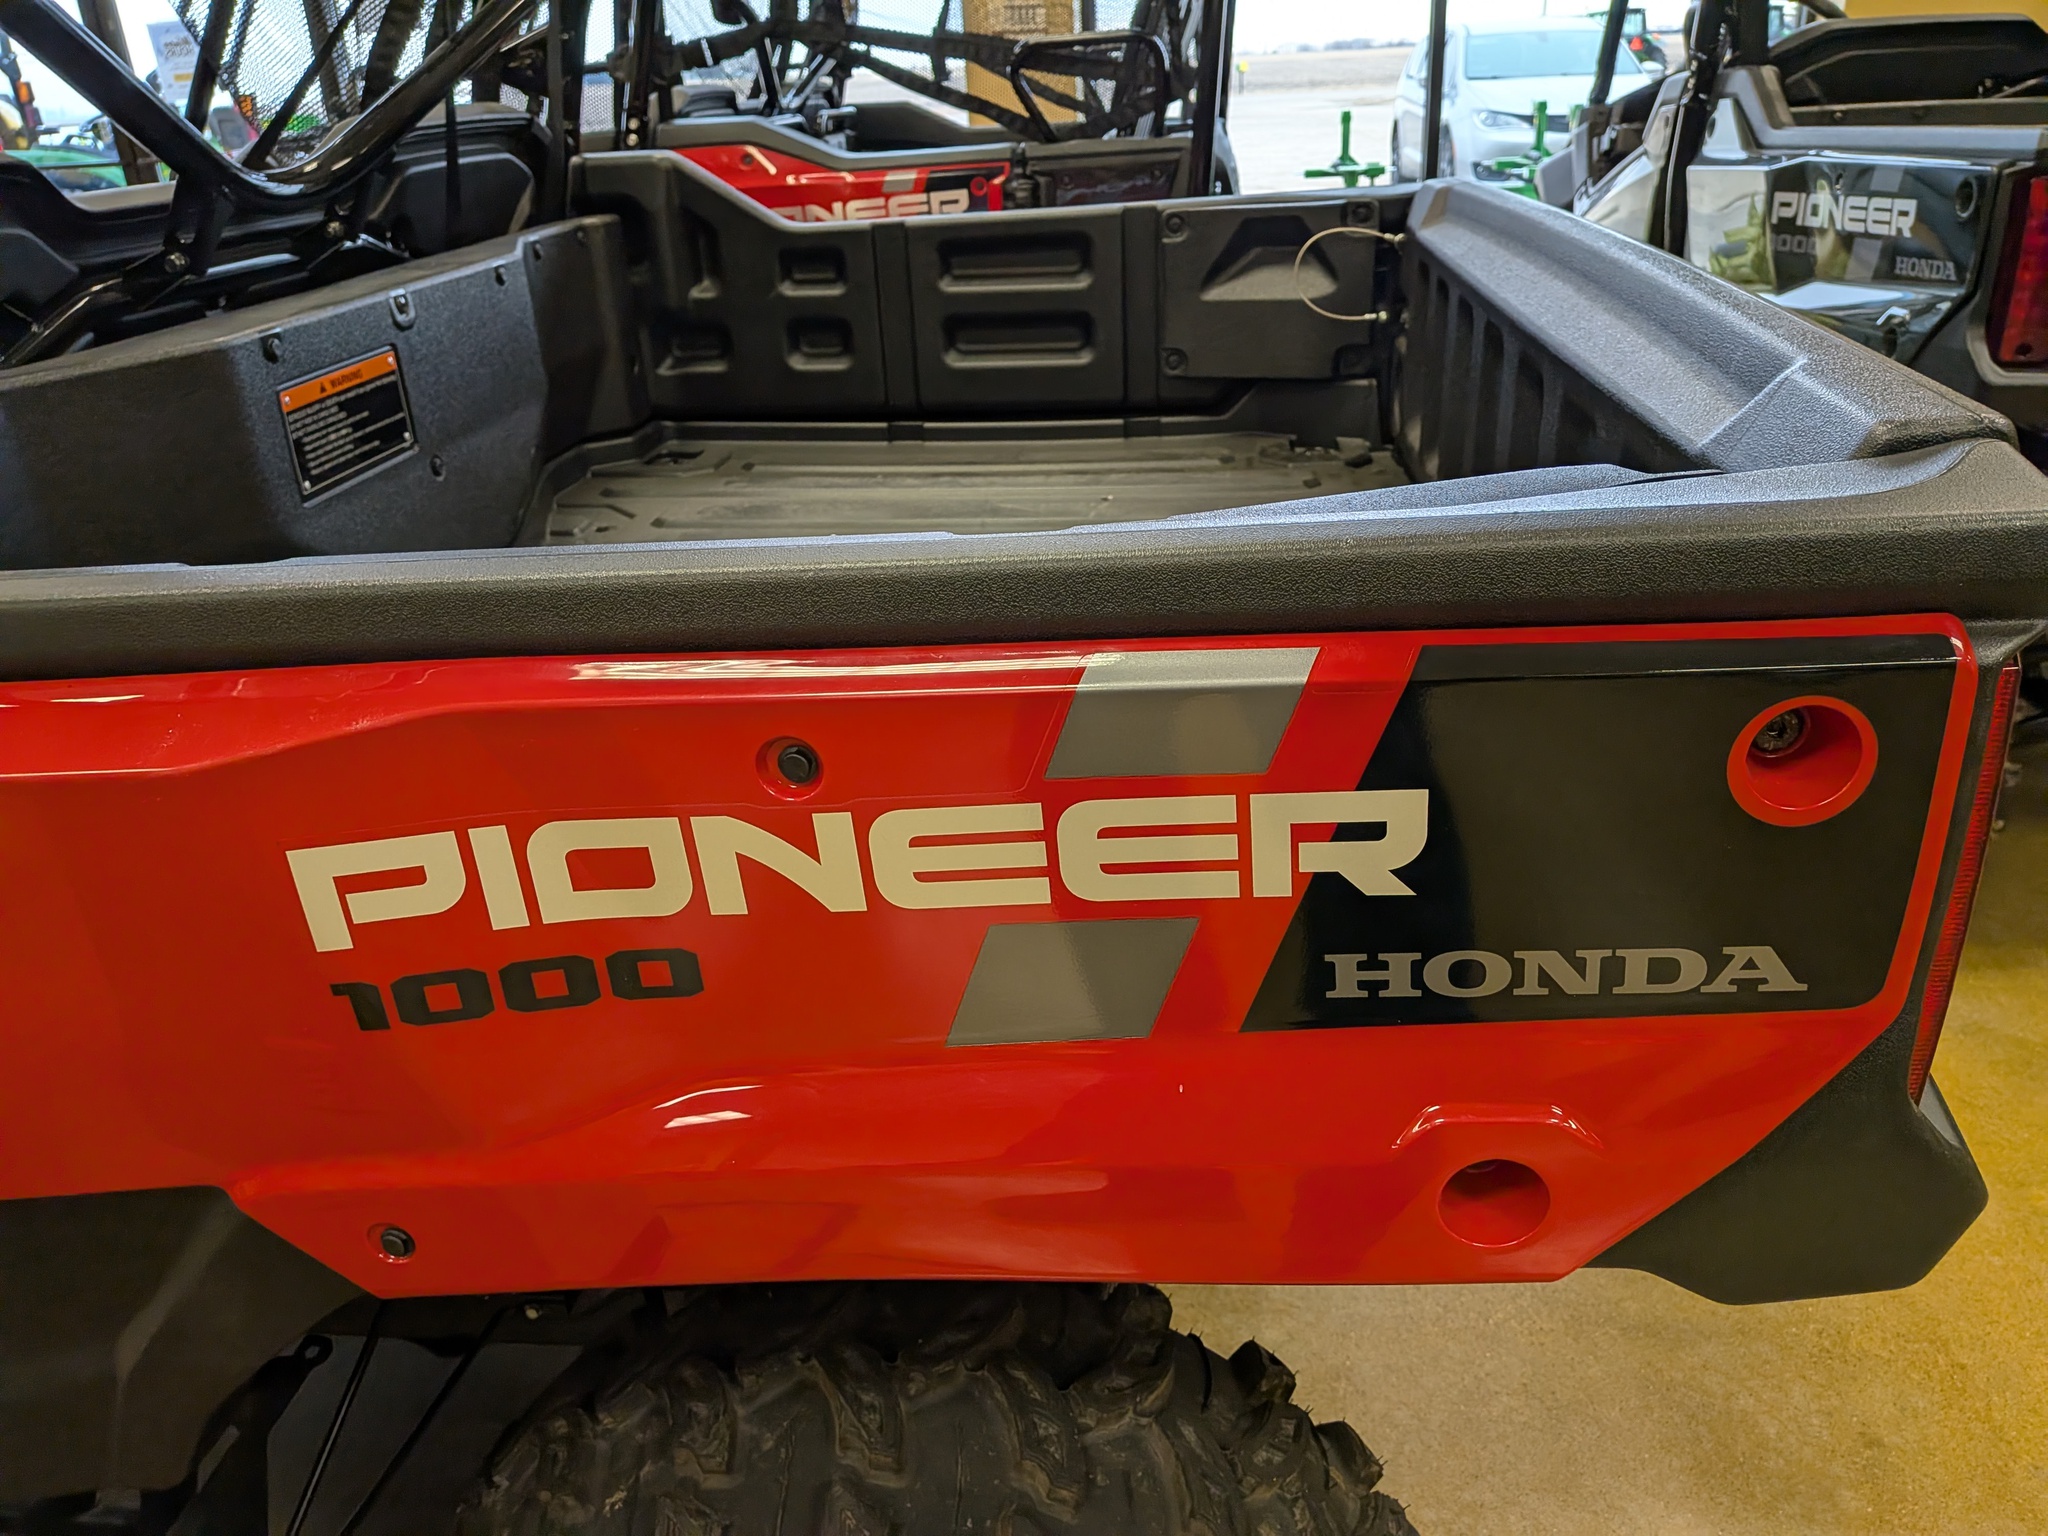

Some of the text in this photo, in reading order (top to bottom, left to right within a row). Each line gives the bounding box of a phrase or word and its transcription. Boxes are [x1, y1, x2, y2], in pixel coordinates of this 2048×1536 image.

[1771, 191, 1917, 238] PIONEER
[1894, 255, 1957, 281] HONDA
[286, 789, 1429, 952] PIONEER
[330, 948, 704, 1031] 1000
[1325, 946, 1808, 999] HONDA
